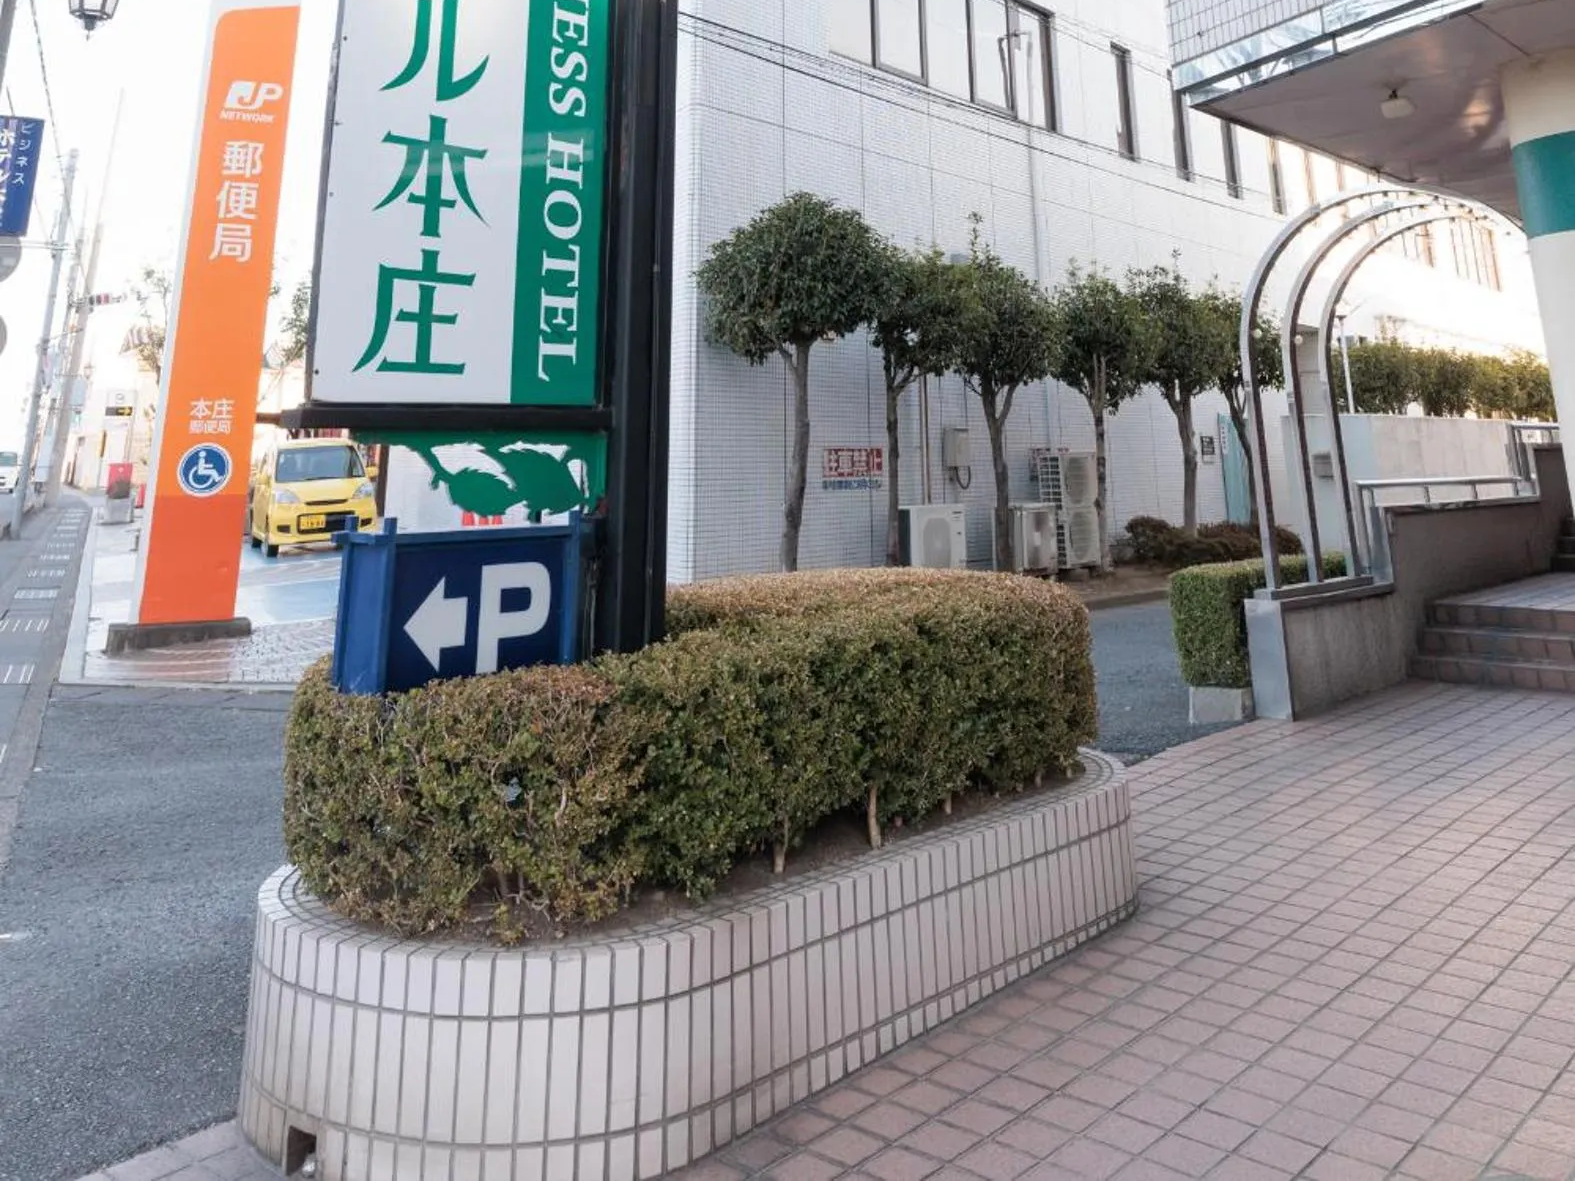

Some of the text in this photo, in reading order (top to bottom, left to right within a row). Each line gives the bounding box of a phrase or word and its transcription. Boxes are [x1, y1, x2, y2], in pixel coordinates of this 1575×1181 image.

[219, 108, 275, 124] NETWORK
[208, 140, 265, 263] 郵便局
[537, 130, 594, 383] HOTEL
[189, 397, 236, 419] 本庄
[476, 561, 552, 675] P
